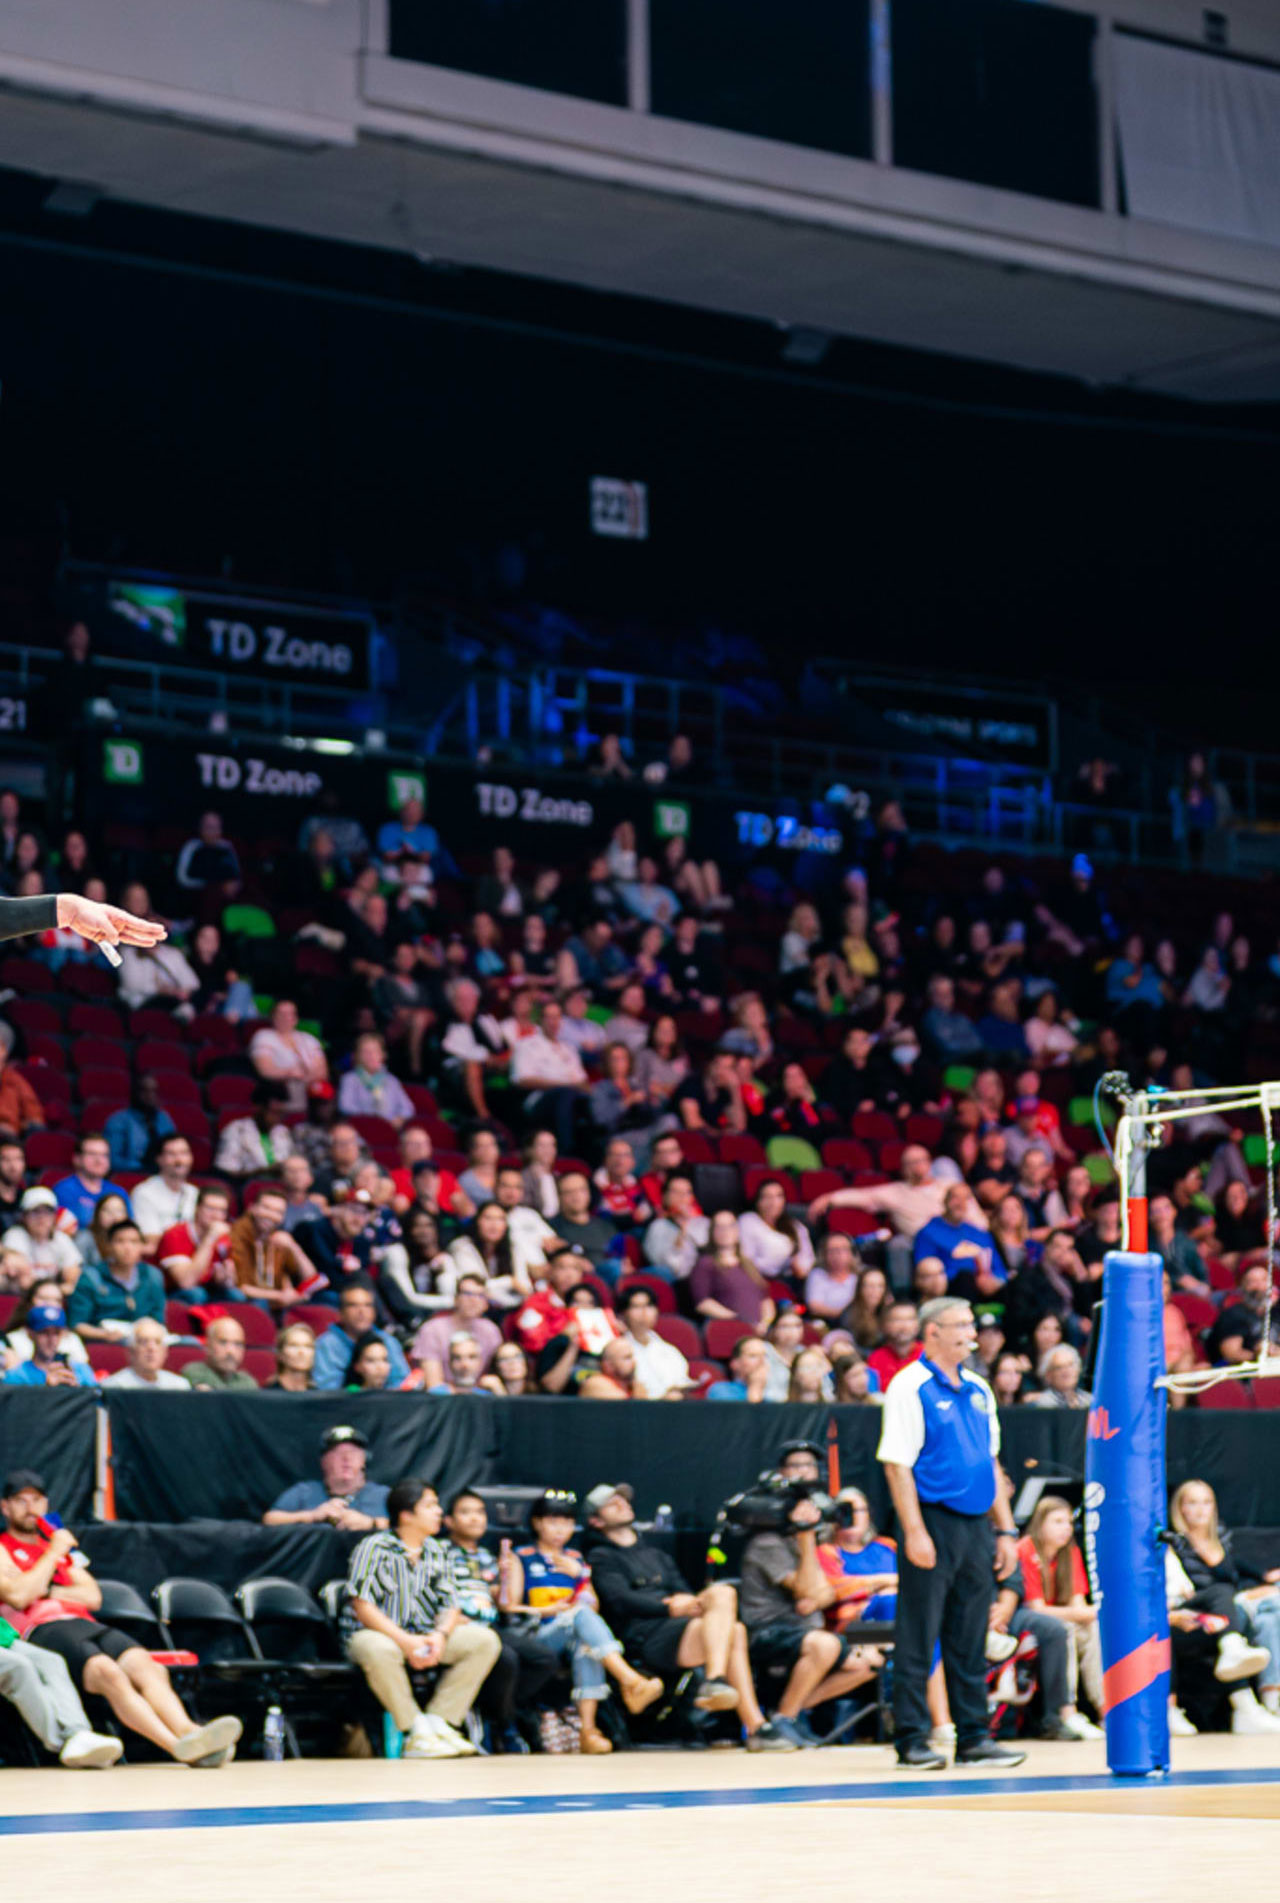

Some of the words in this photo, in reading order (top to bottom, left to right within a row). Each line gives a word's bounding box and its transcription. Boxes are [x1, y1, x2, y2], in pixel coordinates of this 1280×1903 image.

[206, 617, 256, 661] TD
[264, 626, 352, 674] Zone
[197, 753, 240, 789] TD
[246, 759, 322, 795] Zone
[476, 783, 517, 817] TD
[521, 789, 593, 826] Zone
[734, 810, 773, 847] TD
[776, 815, 843, 855] Zone
